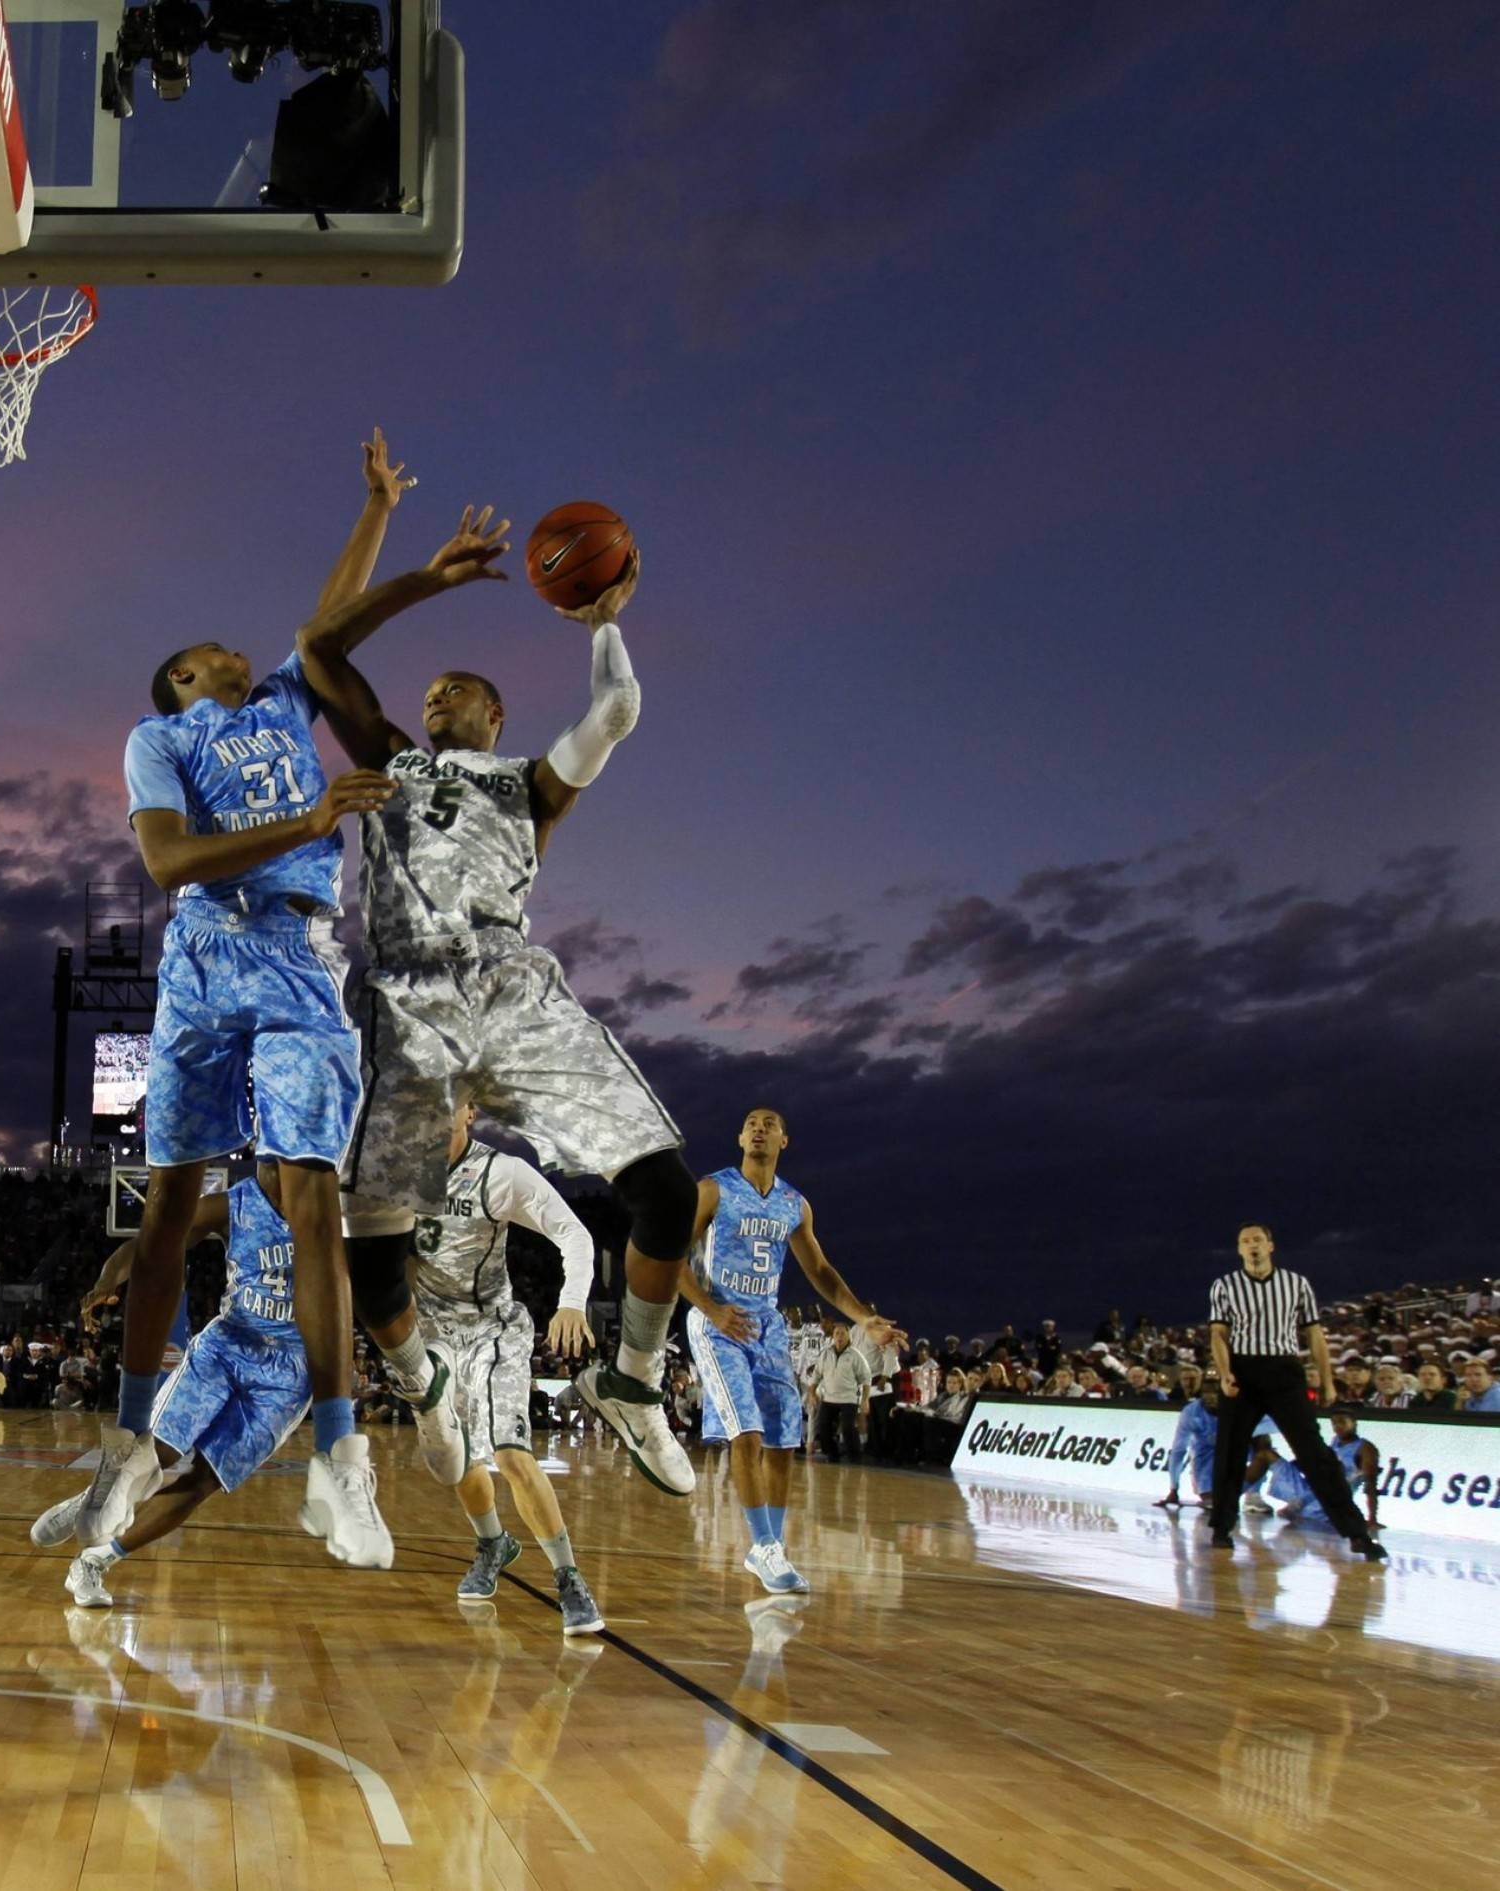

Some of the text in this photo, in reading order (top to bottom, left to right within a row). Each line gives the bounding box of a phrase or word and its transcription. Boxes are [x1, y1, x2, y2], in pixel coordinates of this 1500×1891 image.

[211, 729, 300, 768] NORTH
[240, 754, 306, 809] 31
[422, 780, 466, 832] 5
[739, 1217, 789, 1242] NORTH
[752, 1240, 772, 1273] 5
